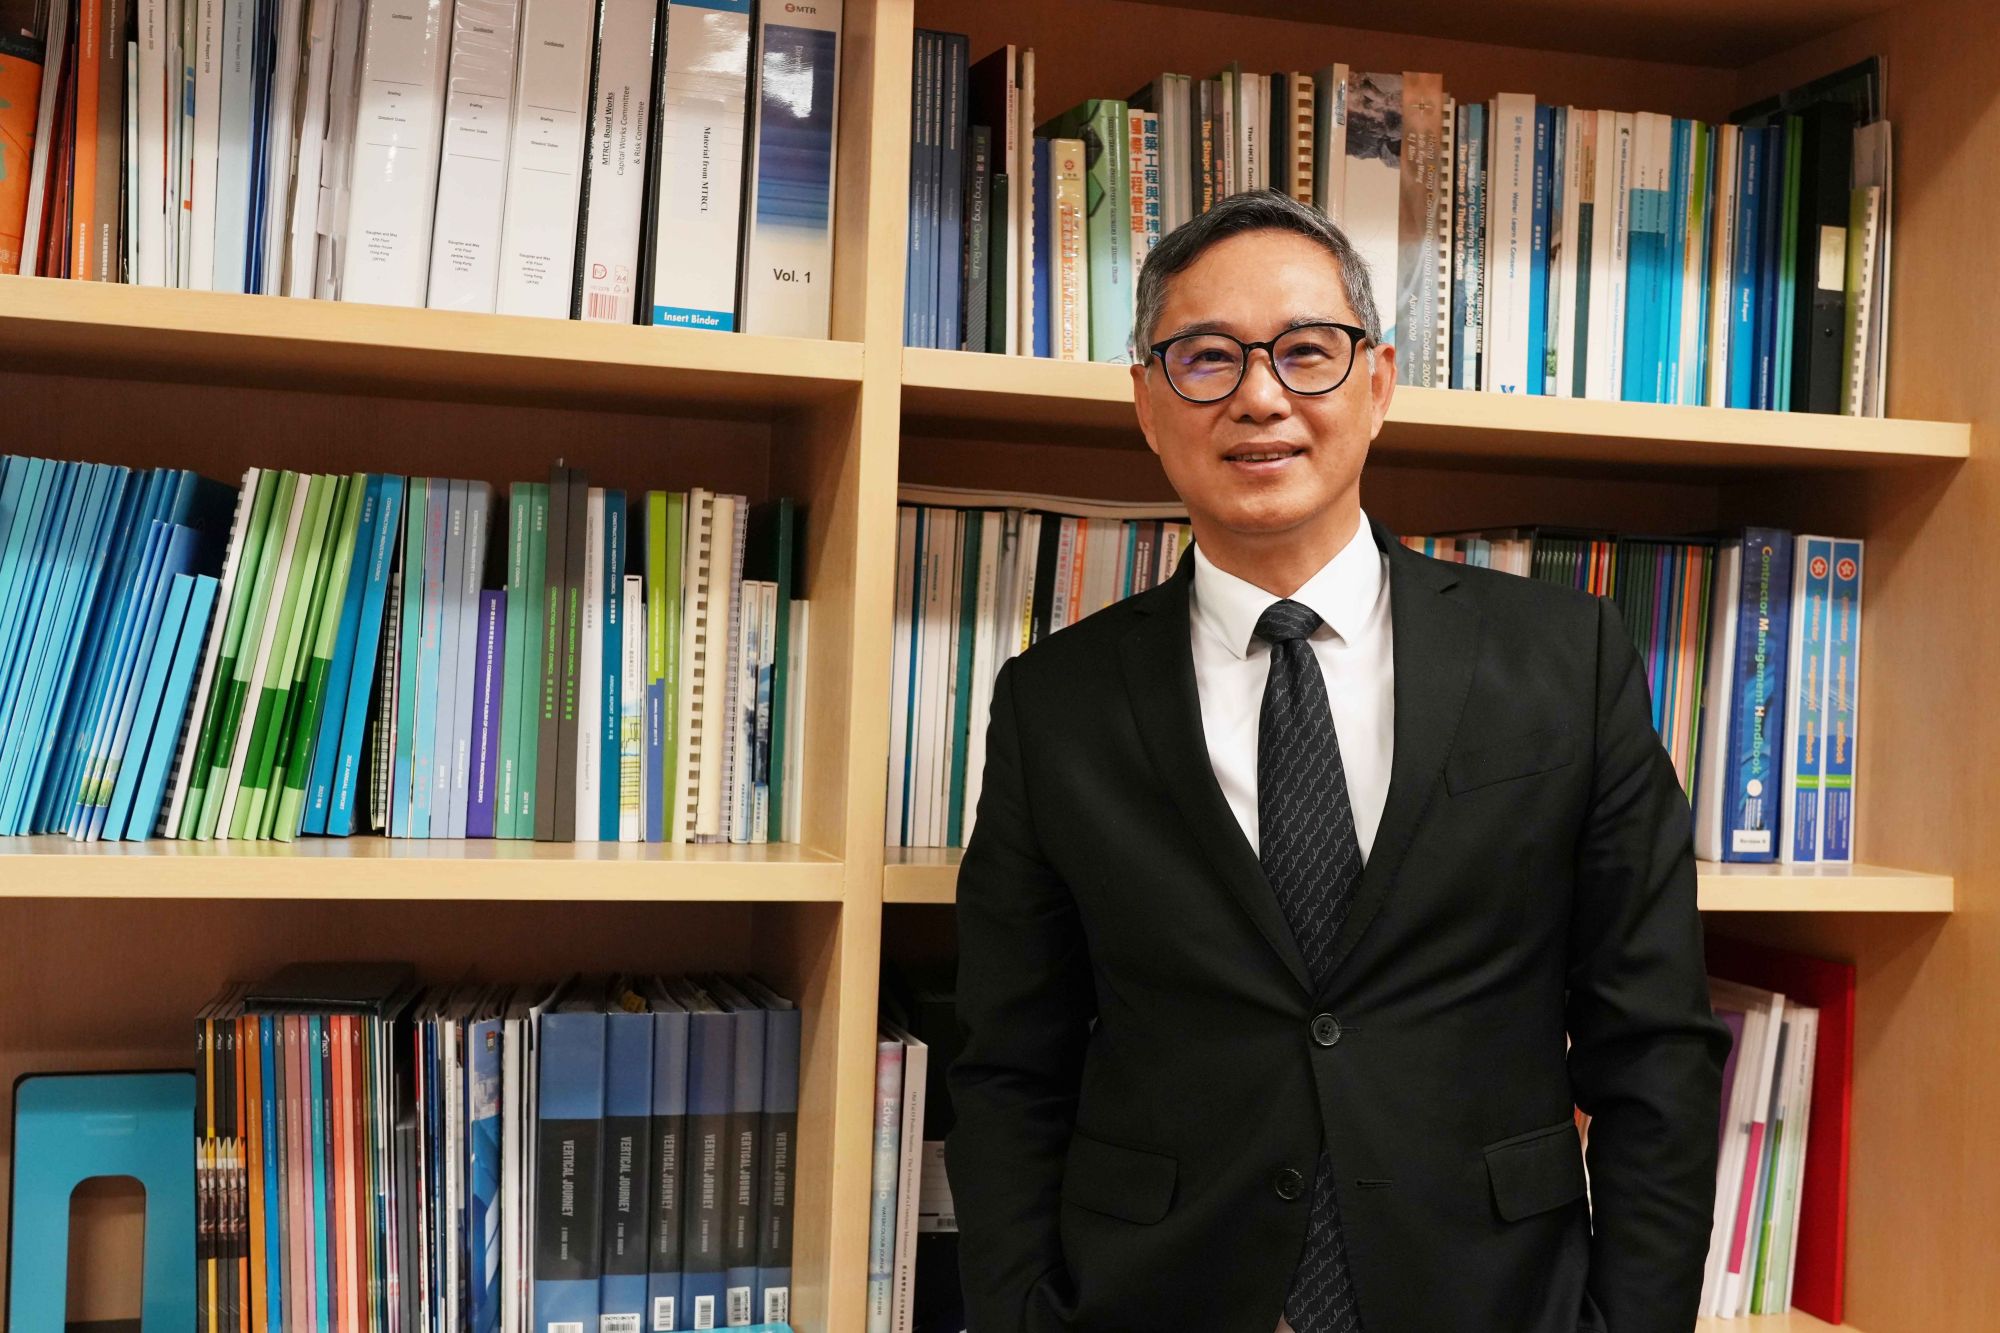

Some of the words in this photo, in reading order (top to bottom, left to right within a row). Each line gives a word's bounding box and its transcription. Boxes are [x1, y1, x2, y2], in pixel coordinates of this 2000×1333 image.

[796, 6, 816, 15] MTR
[605, 92, 615, 115] Works
[620, 86, 630, 126] Committee
[604, 116, 613, 139] Board
[635, 101, 645, 141] Committee
[1202, 120, 1212, 138] The
[618, 127, 627, 149] Works
[633, 142, 641, 157] Risk
[702, 127, 711, 159] Material
[1427, 134, 1437, 160] Hong
[1459, 143, 1468, 161] The
[1470, 139, 1479, 156] The
[602, 140, 611, 166] MTRCL
[617, 151, 626, 176] Capital
[1201, 140, 1212, 171] Shape
[1407, 145, 1415, 161] Allen
[701, 160, 710, 179] from
[1130, 117, 1144, 234] 國際工程管理
[1204, 173, 1212, 184] of
[1416, 165, 1424, 184] Wong
[1426, 164, 1436, 190] Kong
[1458, 163, 1468, 193] Shape
[700, 181, 709, 214] MTRCL
[973, 176, 985, 198] Hong
[1202, 186, 1213, 214] Thing
[1459, 195, 1467, 206] of
[1468, 179, 1477, 204] Kong
[971, 200, 984, 222] Kong
[1425, 192, 1435, 229] Conduit
[1511, 191, 1519, 216] Water:
[973, 223, 984, 251] Green
[1456, 208, 1466, 238] Things
[1466, 204, 1477, 248] Quarrying
[1510, 217, 1518, 238] Learn
[1424, 232, 1435, 276] Condition
[1457, 240, 1465, 251] to
[773, 268, 799, 283] Vol.
[804, 271, 811, 284] 1
[972, 251, 983, 279] Routes
[1062, 262, 1072, 296] SAFETY
[1457, 253, 1465, 280] Come
[1409, 293, 1418, 316] April
[1423, 278, 1433, 327] Evaluation
[1741, 303, 1749, 322] Report
[663, 311, 689, 323] Insert
[690, 314, 720, 326] Binder
[1409, 317, 1417, 341] 2009
[1422, 330, 1432, 361] Codes
[1422, 363, 1431, 388] 2009
[382, 497, 392, 535] CONSTRUCTION
[378, 535, 386, 560] INDUSTRY
[1165, 533, 1176, 580] Geotechnica
[374, 560, 382, 582] COUNCIL
[1759, 546, 1773, 616] Contractor
[1754, 617, 1769, 704] Management
[484, 665, 492, 704] COMMEMORATIVE
[480, 727, 488, 761] CONSTRUCTION
[1751, 705, 1765, 774] Handbook
[880, 1098, 894, 1148] Edward
[562, 1139, 575, 1177] VERTICAL
[619, 1136, 632, 1174] VERTICAL
[662, 1134, 675, 1172] VERTICAL
[703, 1134, 715, 1172] VERTICAL
[740, 1131, 752, 1169] VERTICAL
[775, 1131, 787, 1169] VERTICAL
[562, 1179, 574, 1217] JOURNEY
[618, 1175, 630, 1213] JOURNEY
[661, 1173, 674, 1209] JOURNEY
[702, 1172, 714, 1209] JOURNEY
[738, 1169, 751, 1206] JOURNEY
[773, 1170, 785, 1206] JOURNEY
[879, 1179, 890, 1200] Ho
[879, 1206, 887, 1248] WATERCOLOUR
